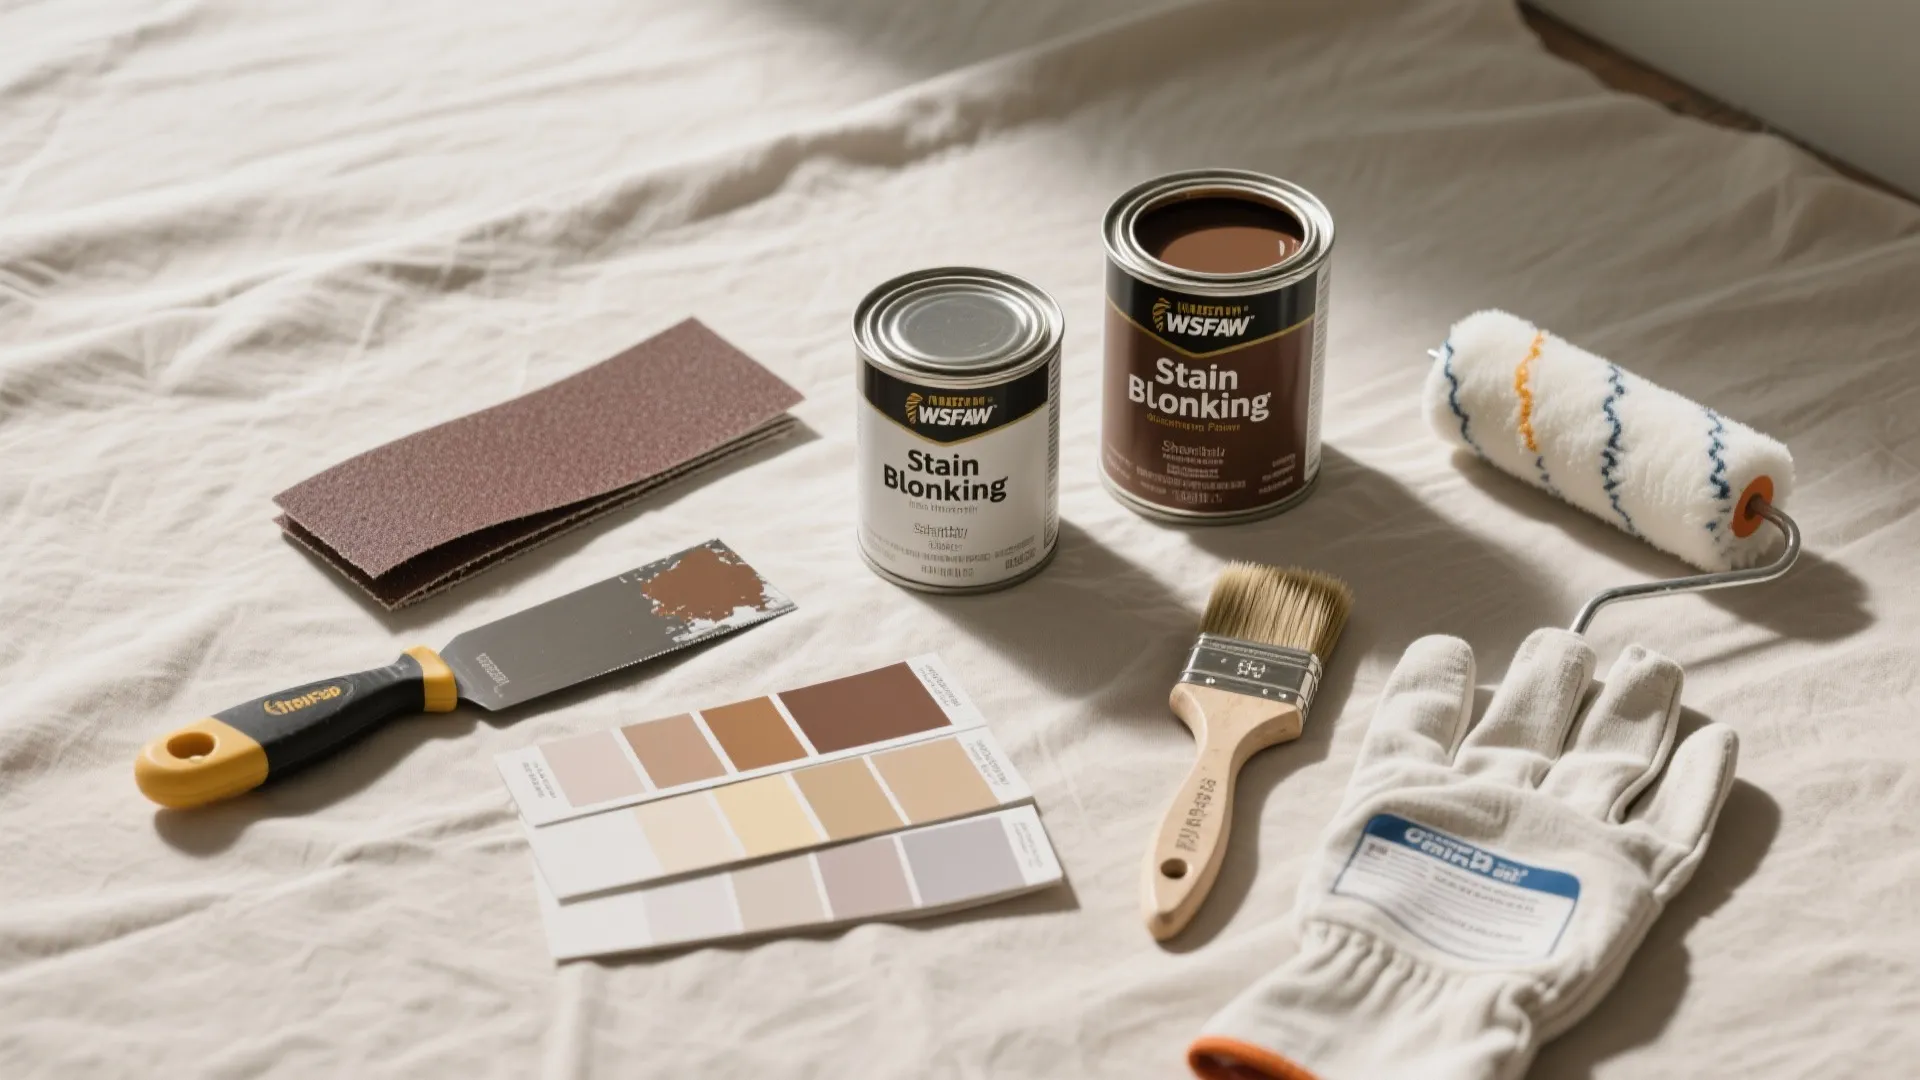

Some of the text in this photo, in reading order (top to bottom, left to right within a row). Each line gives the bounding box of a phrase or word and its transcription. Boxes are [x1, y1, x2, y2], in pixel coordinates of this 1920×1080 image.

[1166, 312, 1251, 337] WSFAW
[1155, 357, 1238, 390] Stain
[1128, 373, 1271, 422] Blonking
[919, 404, 994, 426] WSFAW
[907, 449, 979, 477] Stain
[884, 464, 1008, 503] Blonking
